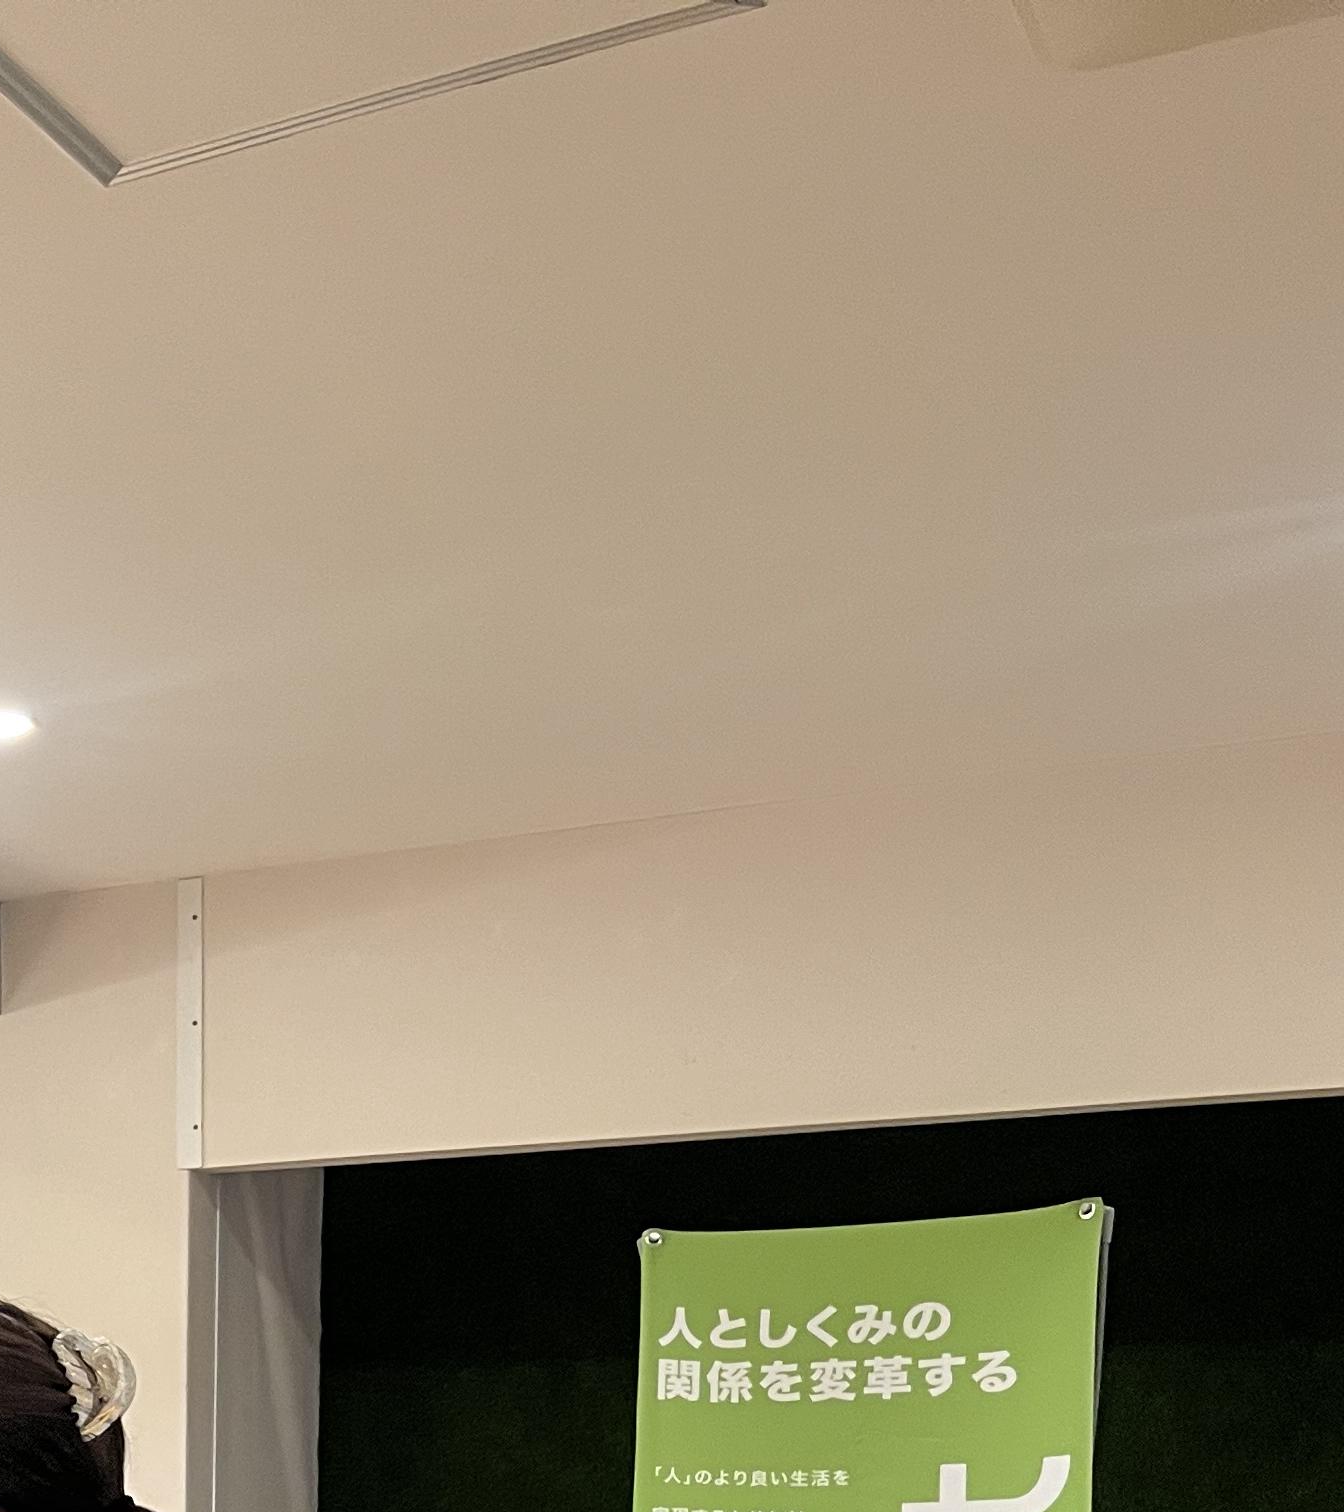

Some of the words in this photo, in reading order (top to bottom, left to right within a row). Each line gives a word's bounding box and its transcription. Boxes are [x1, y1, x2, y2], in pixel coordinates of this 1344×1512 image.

[658, 1302, 952, 1349] 人としくみの
[656, 1350, 1018, 1404] 関係を変革する
[654, 1465, 850, 1488] 「人」のより良い生活を
